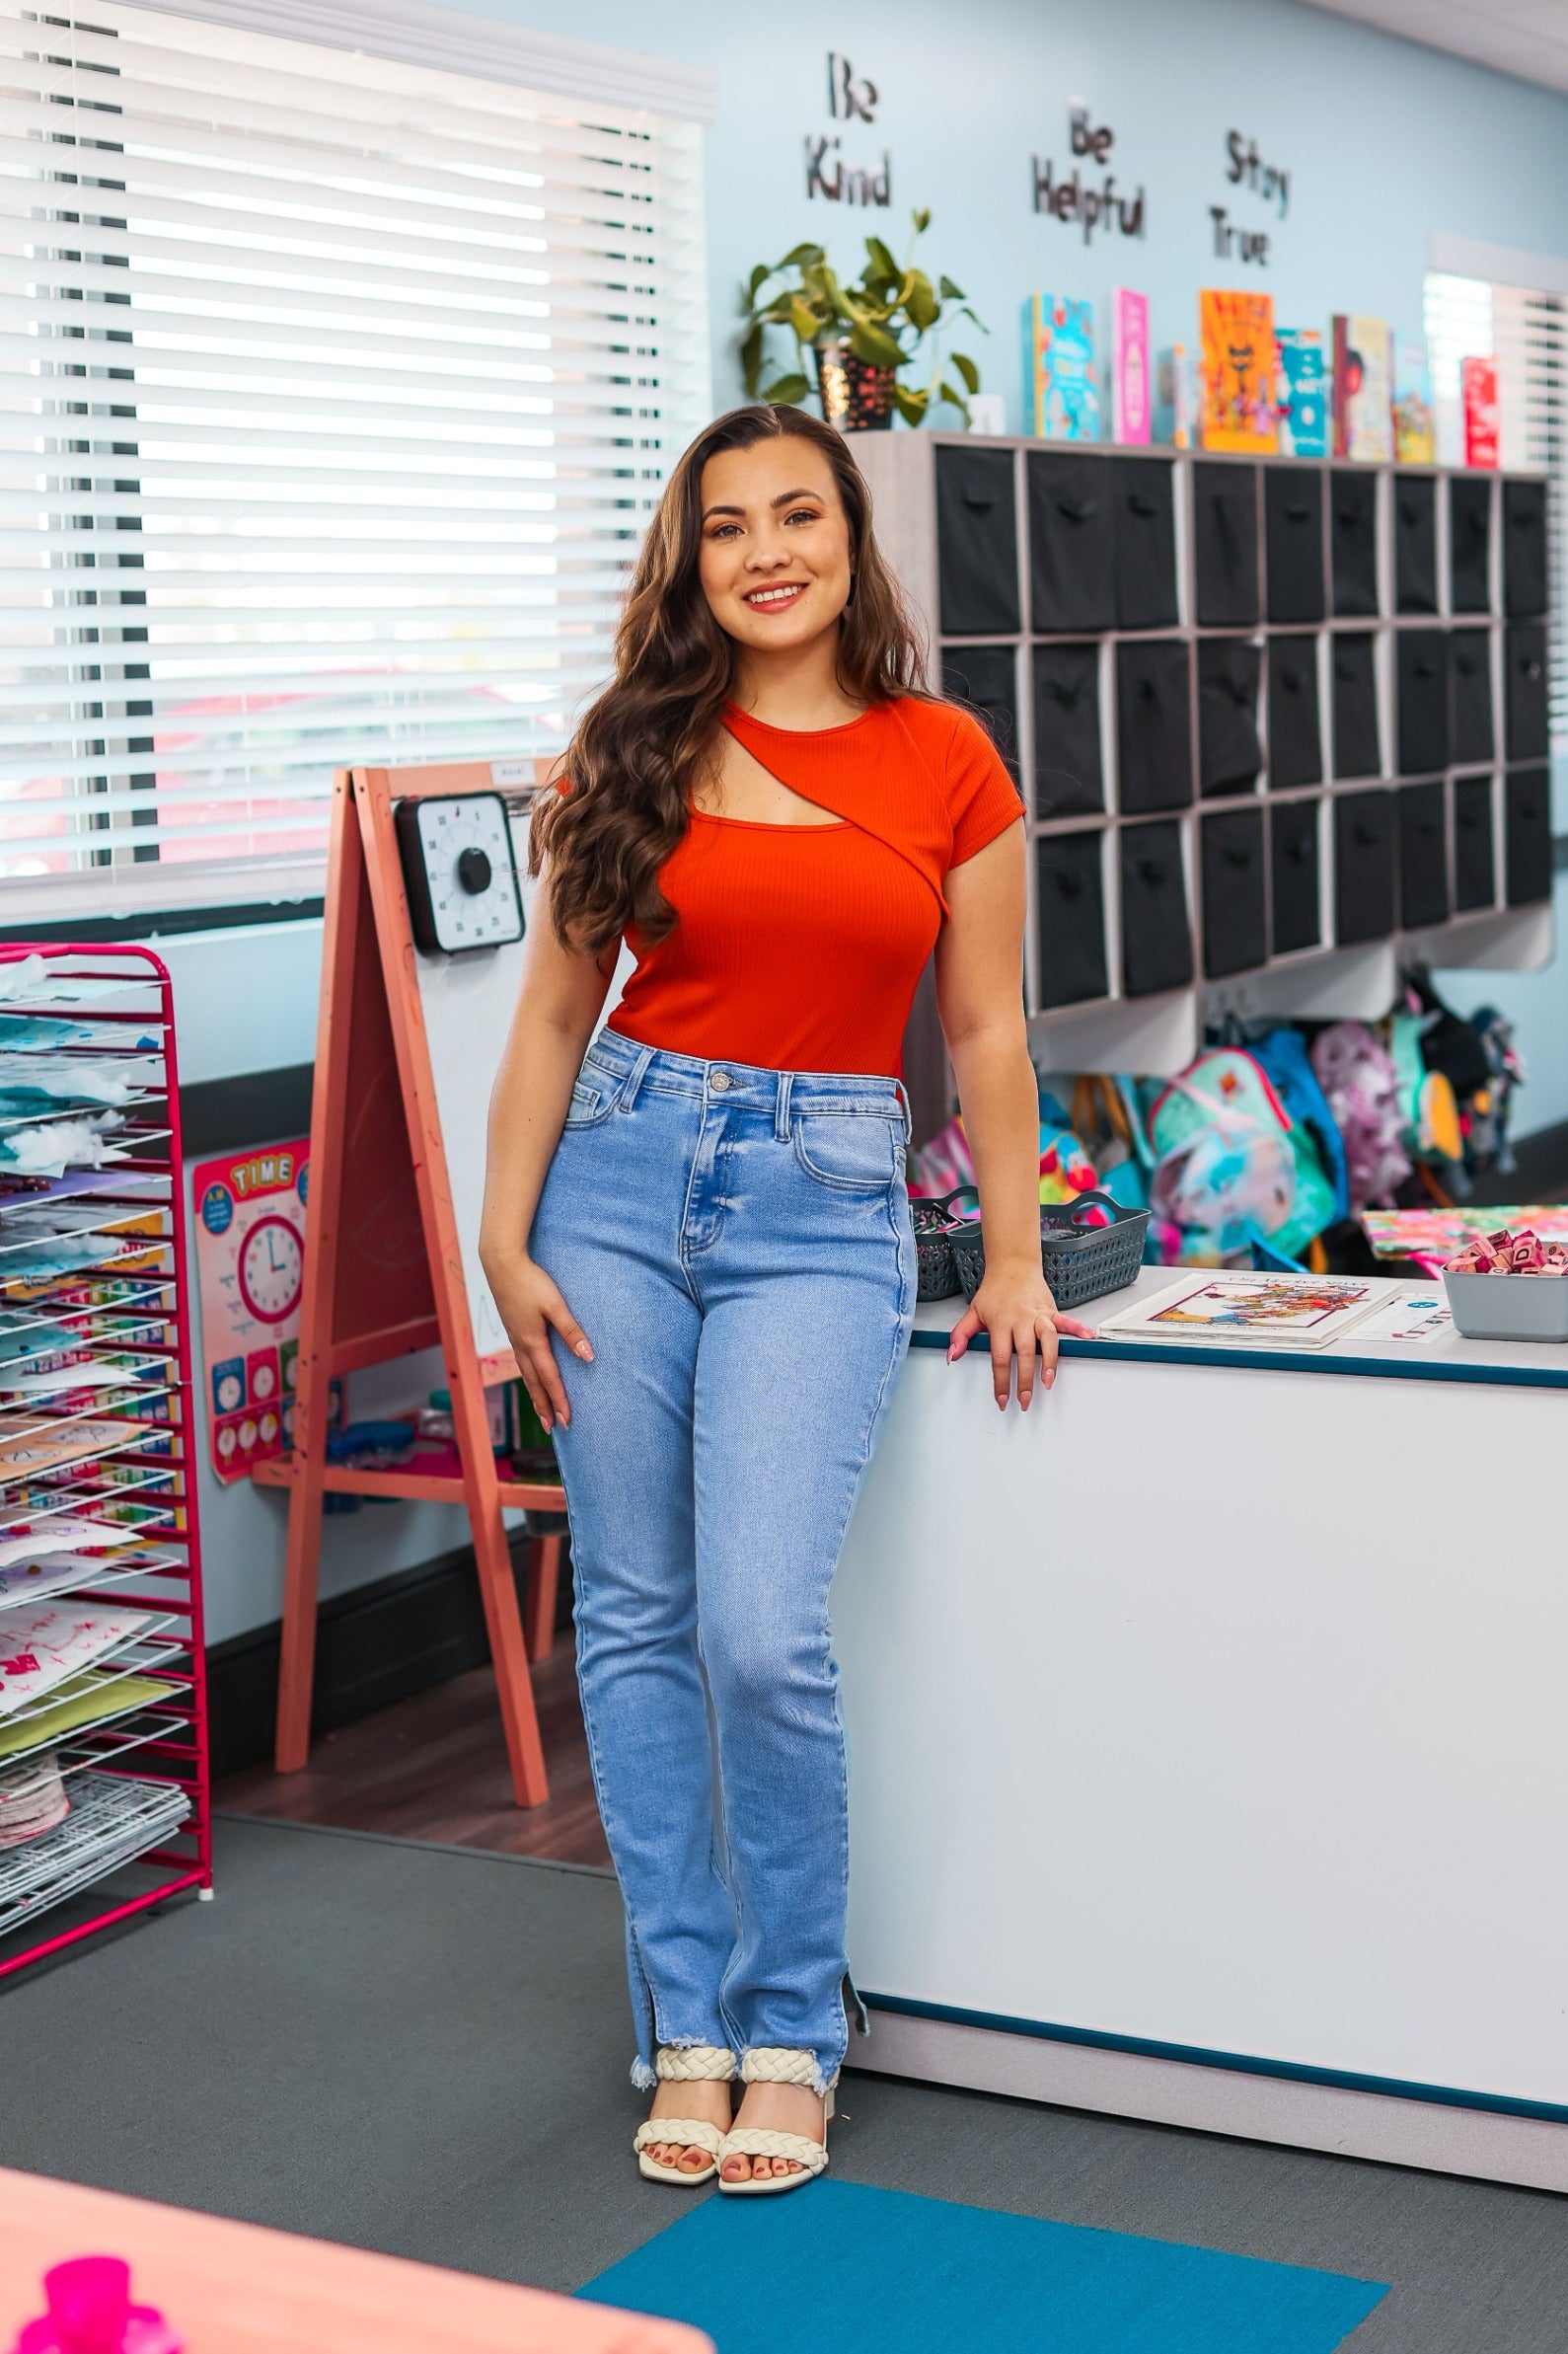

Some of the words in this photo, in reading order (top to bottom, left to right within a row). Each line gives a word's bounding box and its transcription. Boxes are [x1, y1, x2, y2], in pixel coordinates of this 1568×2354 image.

[828, 51, 878, 123] Be
[1069, 97, 1113, 166] Be
[804, 134, 891, 207] Kind
[1031, 153, 1146, 246] Helpful
[1227, 128, 1290, 221] Stay
[1209, 203, 1268, 266] True
[233, 1156, 292, 1193] TIME
[1515, 1248, 1531, 1261] D
